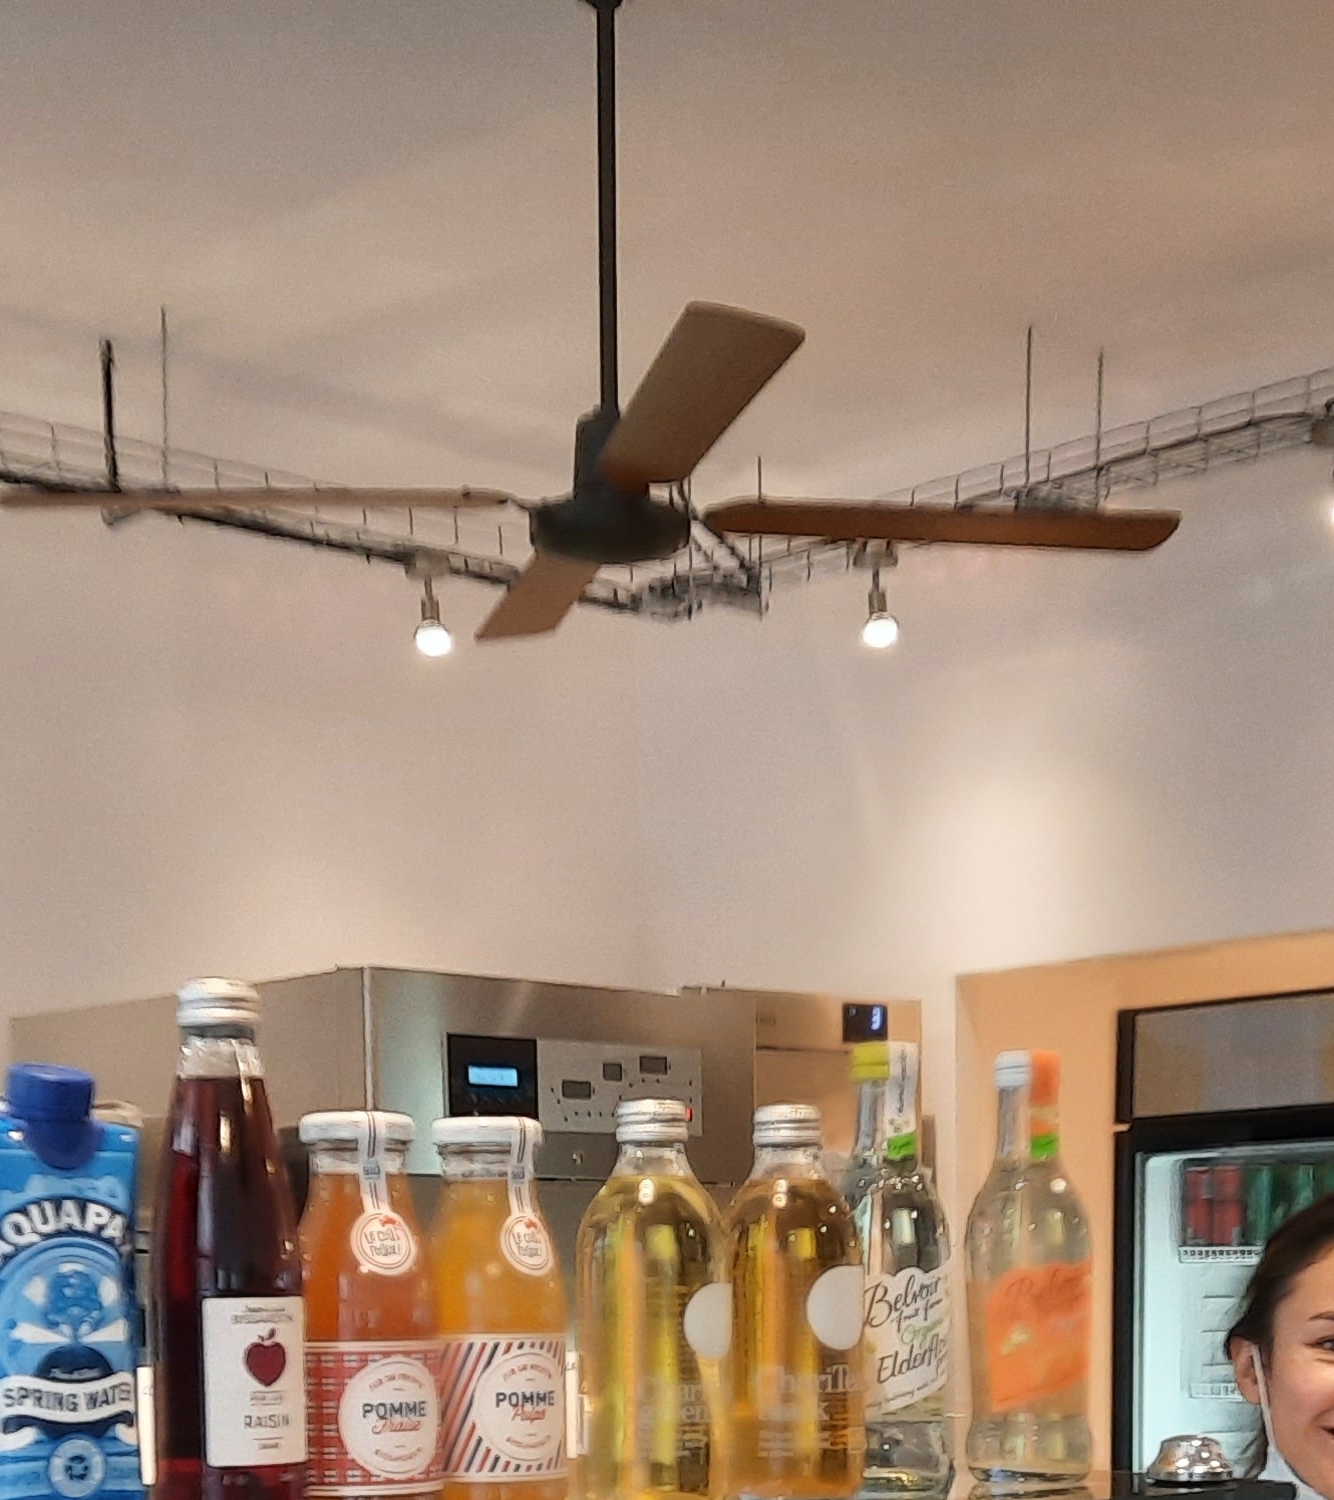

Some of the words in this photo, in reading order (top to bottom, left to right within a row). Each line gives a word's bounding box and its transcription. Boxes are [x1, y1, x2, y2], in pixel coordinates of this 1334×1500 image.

[2, 1384, 79, 1413] SPRING
[495, 1390, 556, 1408] POMME
[362, 1400, 427, 1418] POMME
